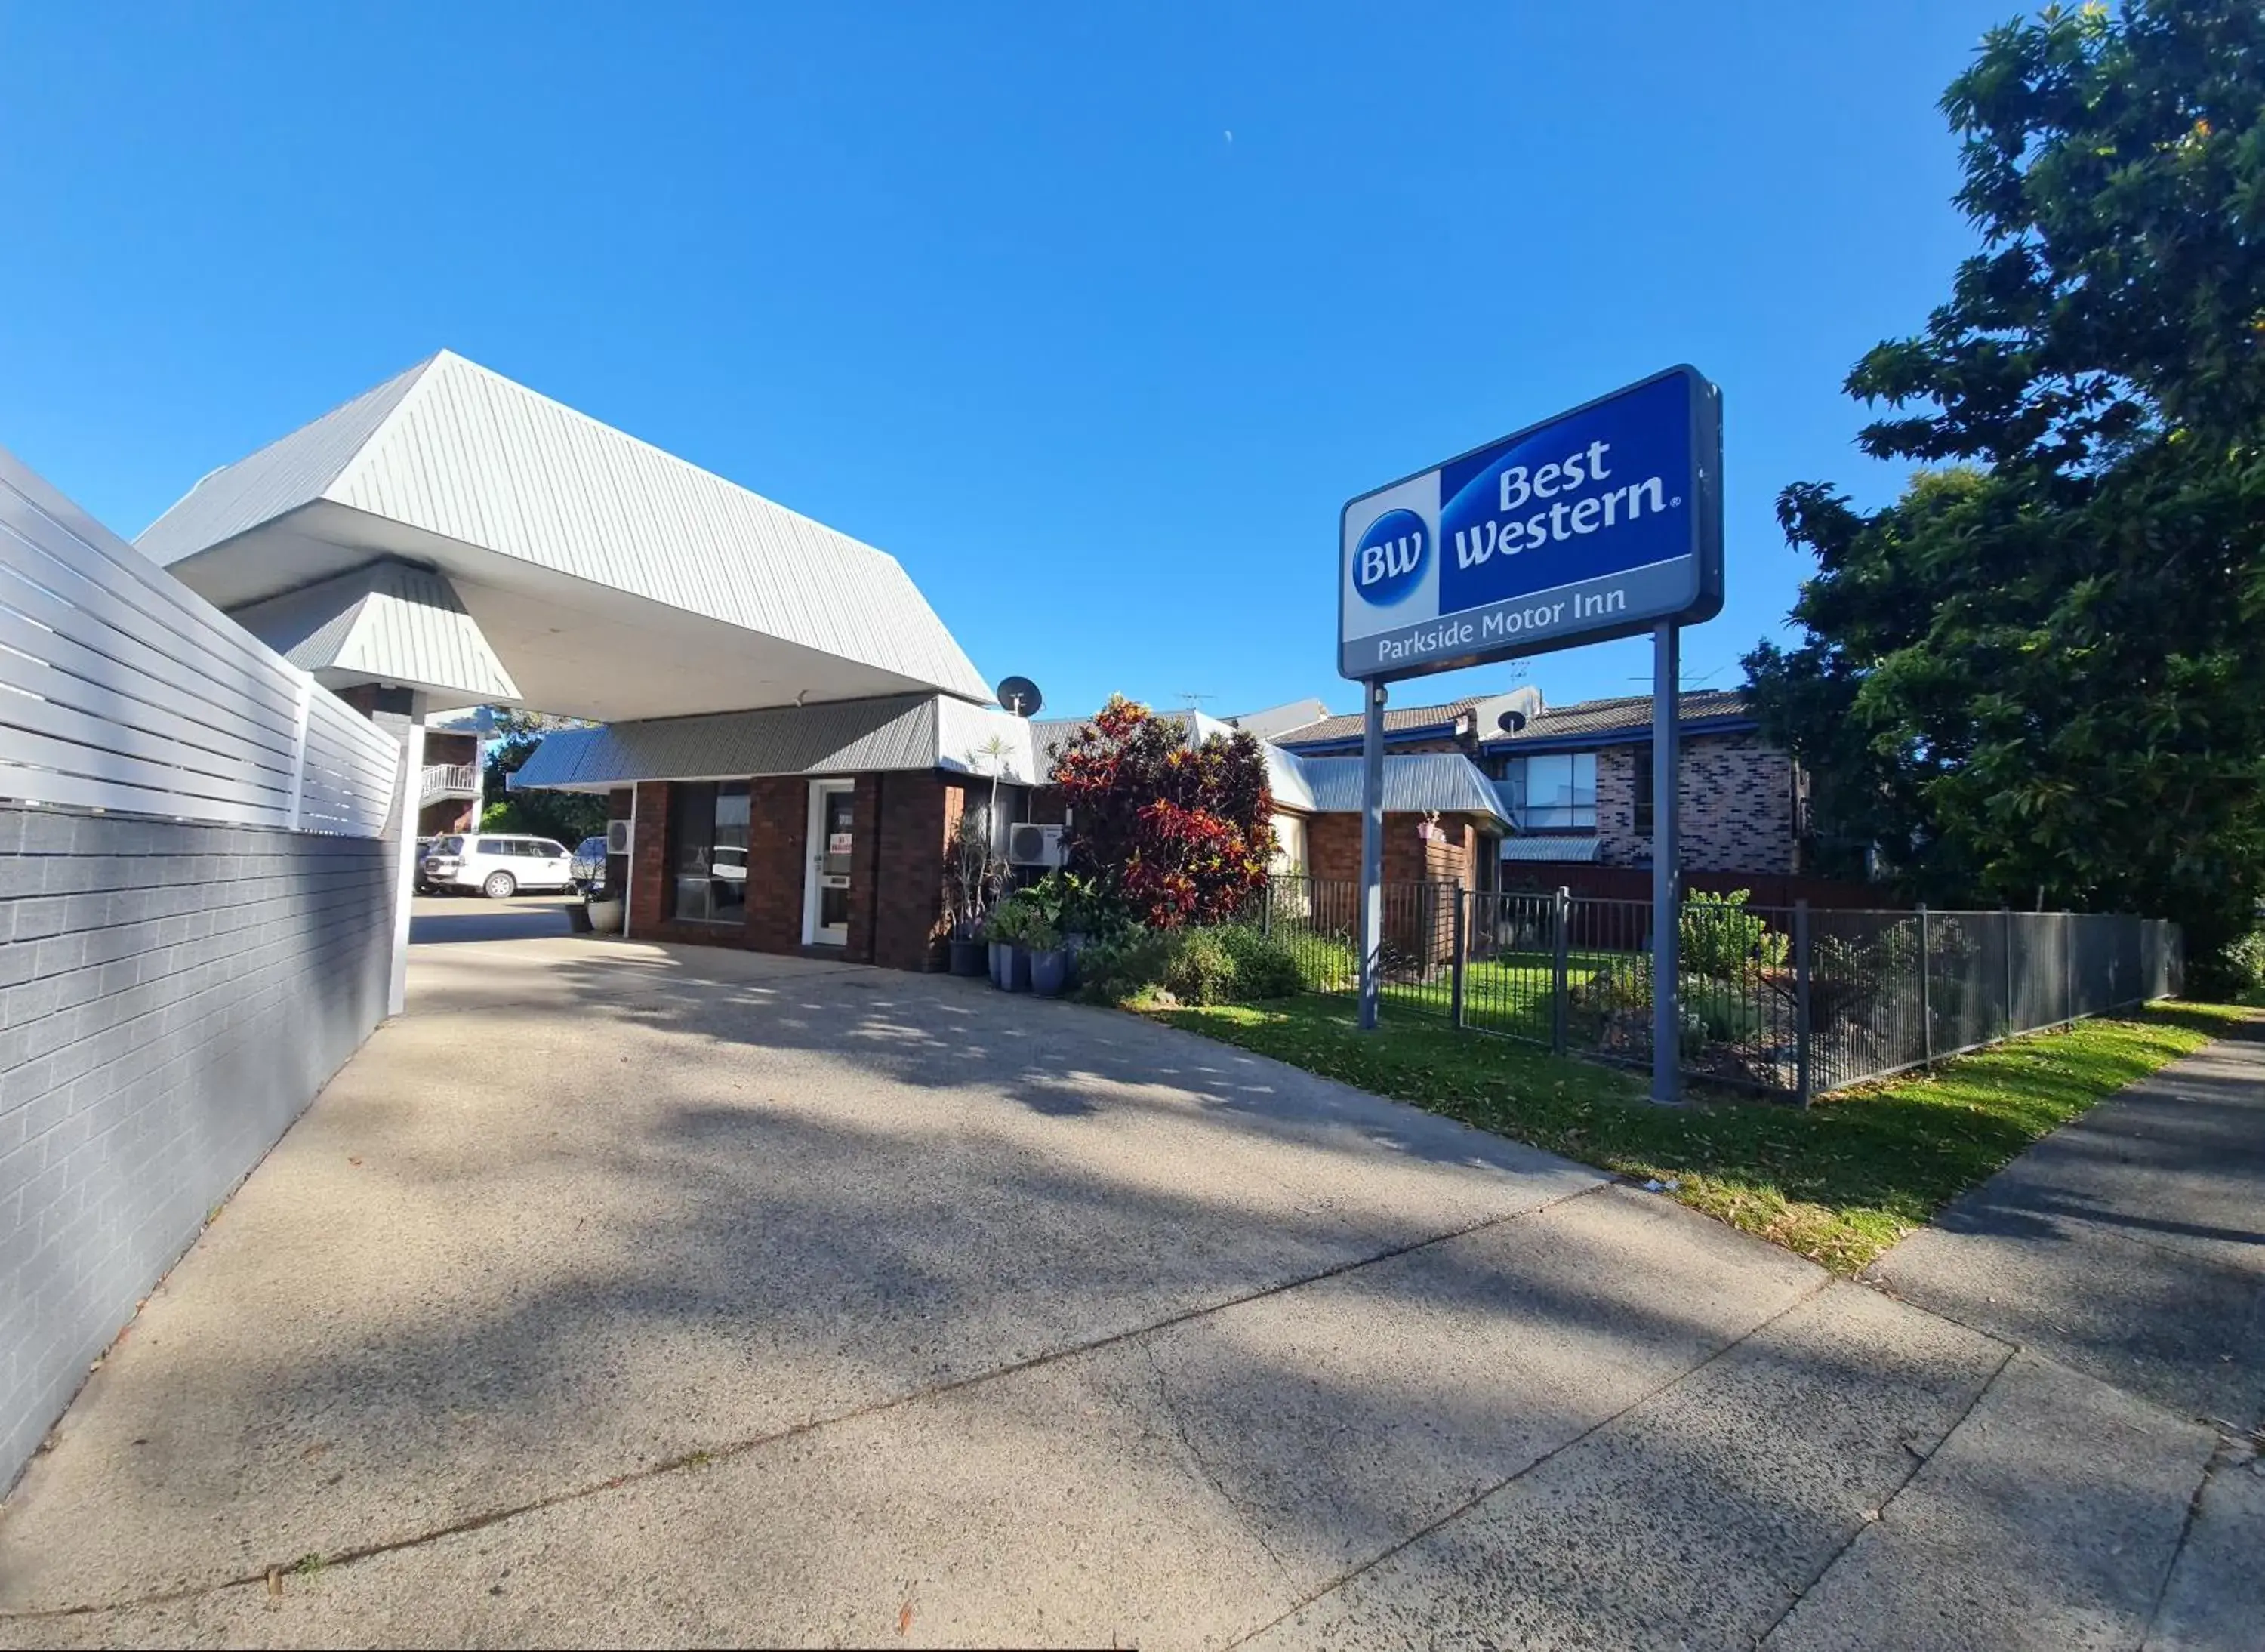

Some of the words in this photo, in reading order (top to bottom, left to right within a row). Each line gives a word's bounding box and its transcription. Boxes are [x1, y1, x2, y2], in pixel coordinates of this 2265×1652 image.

[1499, 440, 1612, 512] Best
[1361, 532, 1422, 585] BW
[1378, 621, 1474, 661] Parkside
[1481, 601, 1565, 638] Motor
[1574, 589, 1626, 618] Inn
